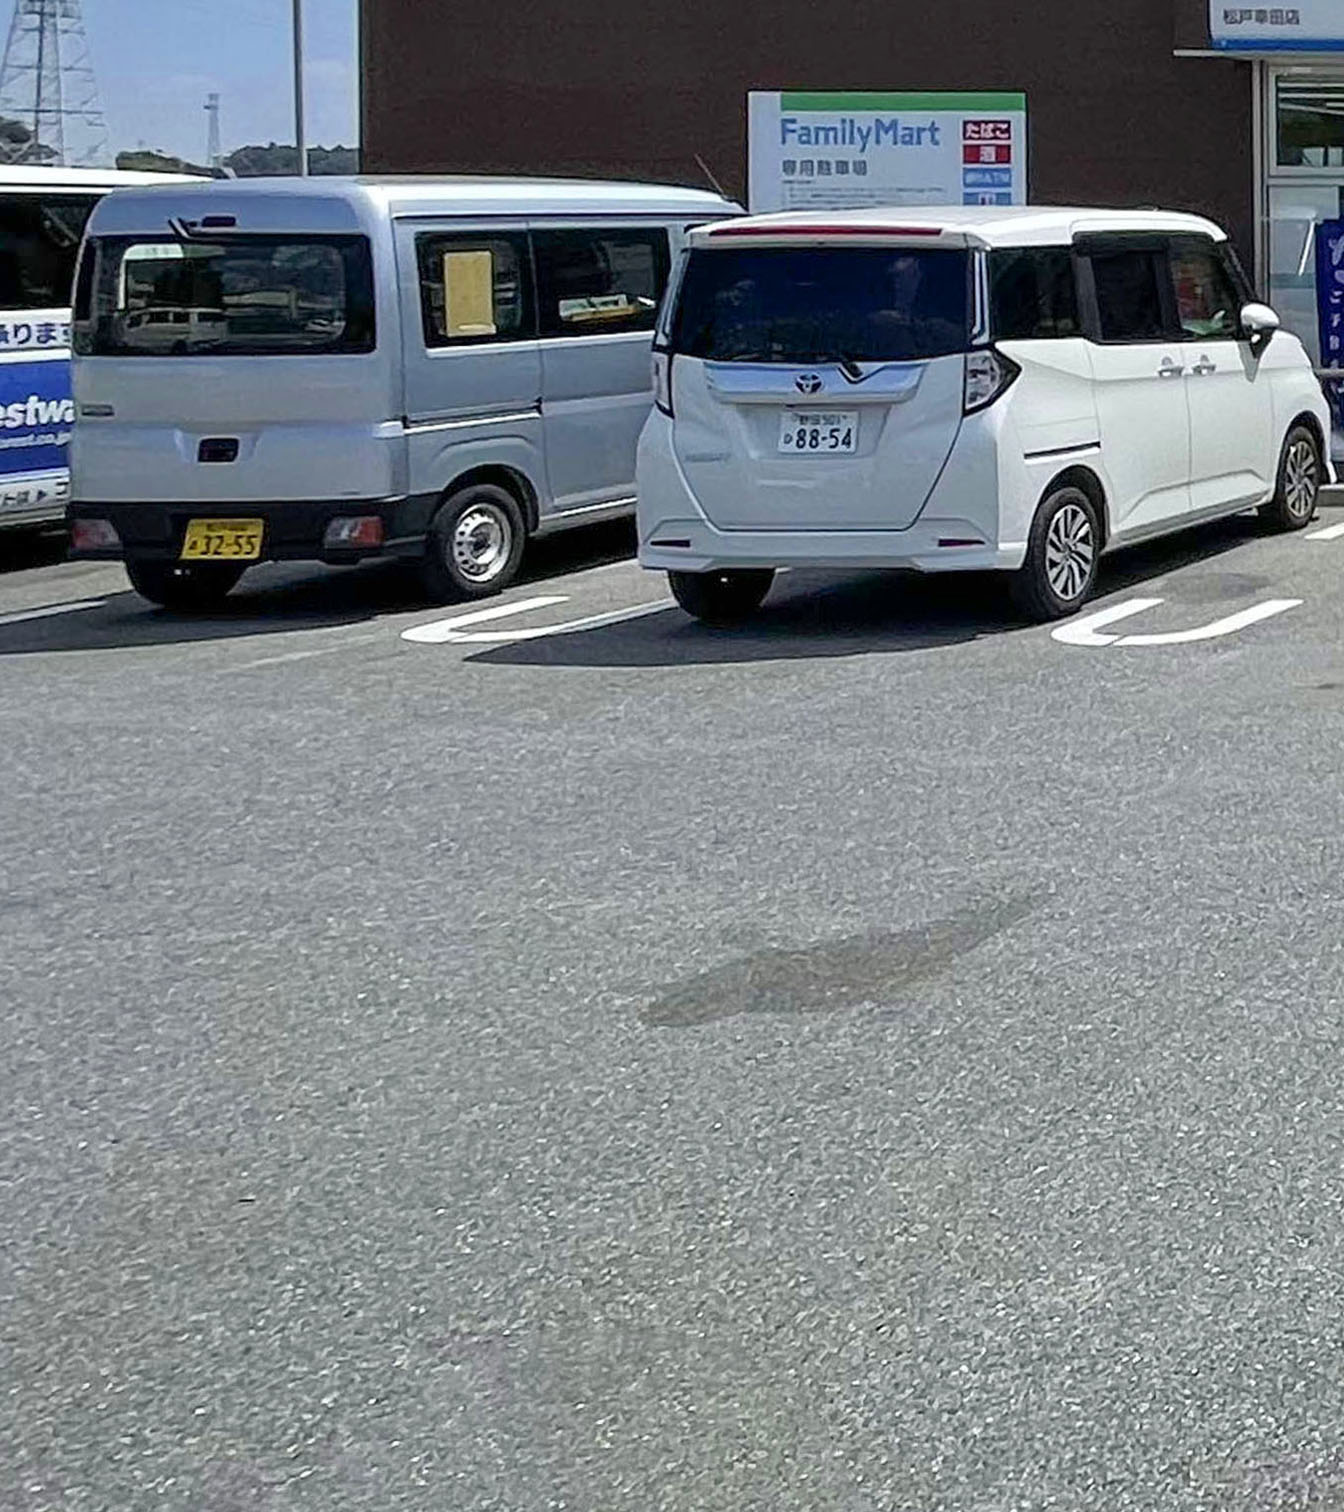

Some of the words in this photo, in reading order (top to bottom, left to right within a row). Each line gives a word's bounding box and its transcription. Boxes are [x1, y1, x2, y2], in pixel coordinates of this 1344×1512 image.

[780, 118, 940, 153] FamilyMart
[965, 122, 1009, 139] たばこ
[796, 428, 852, 449] 88-54
[200, 535, 258, 555] 32-55
